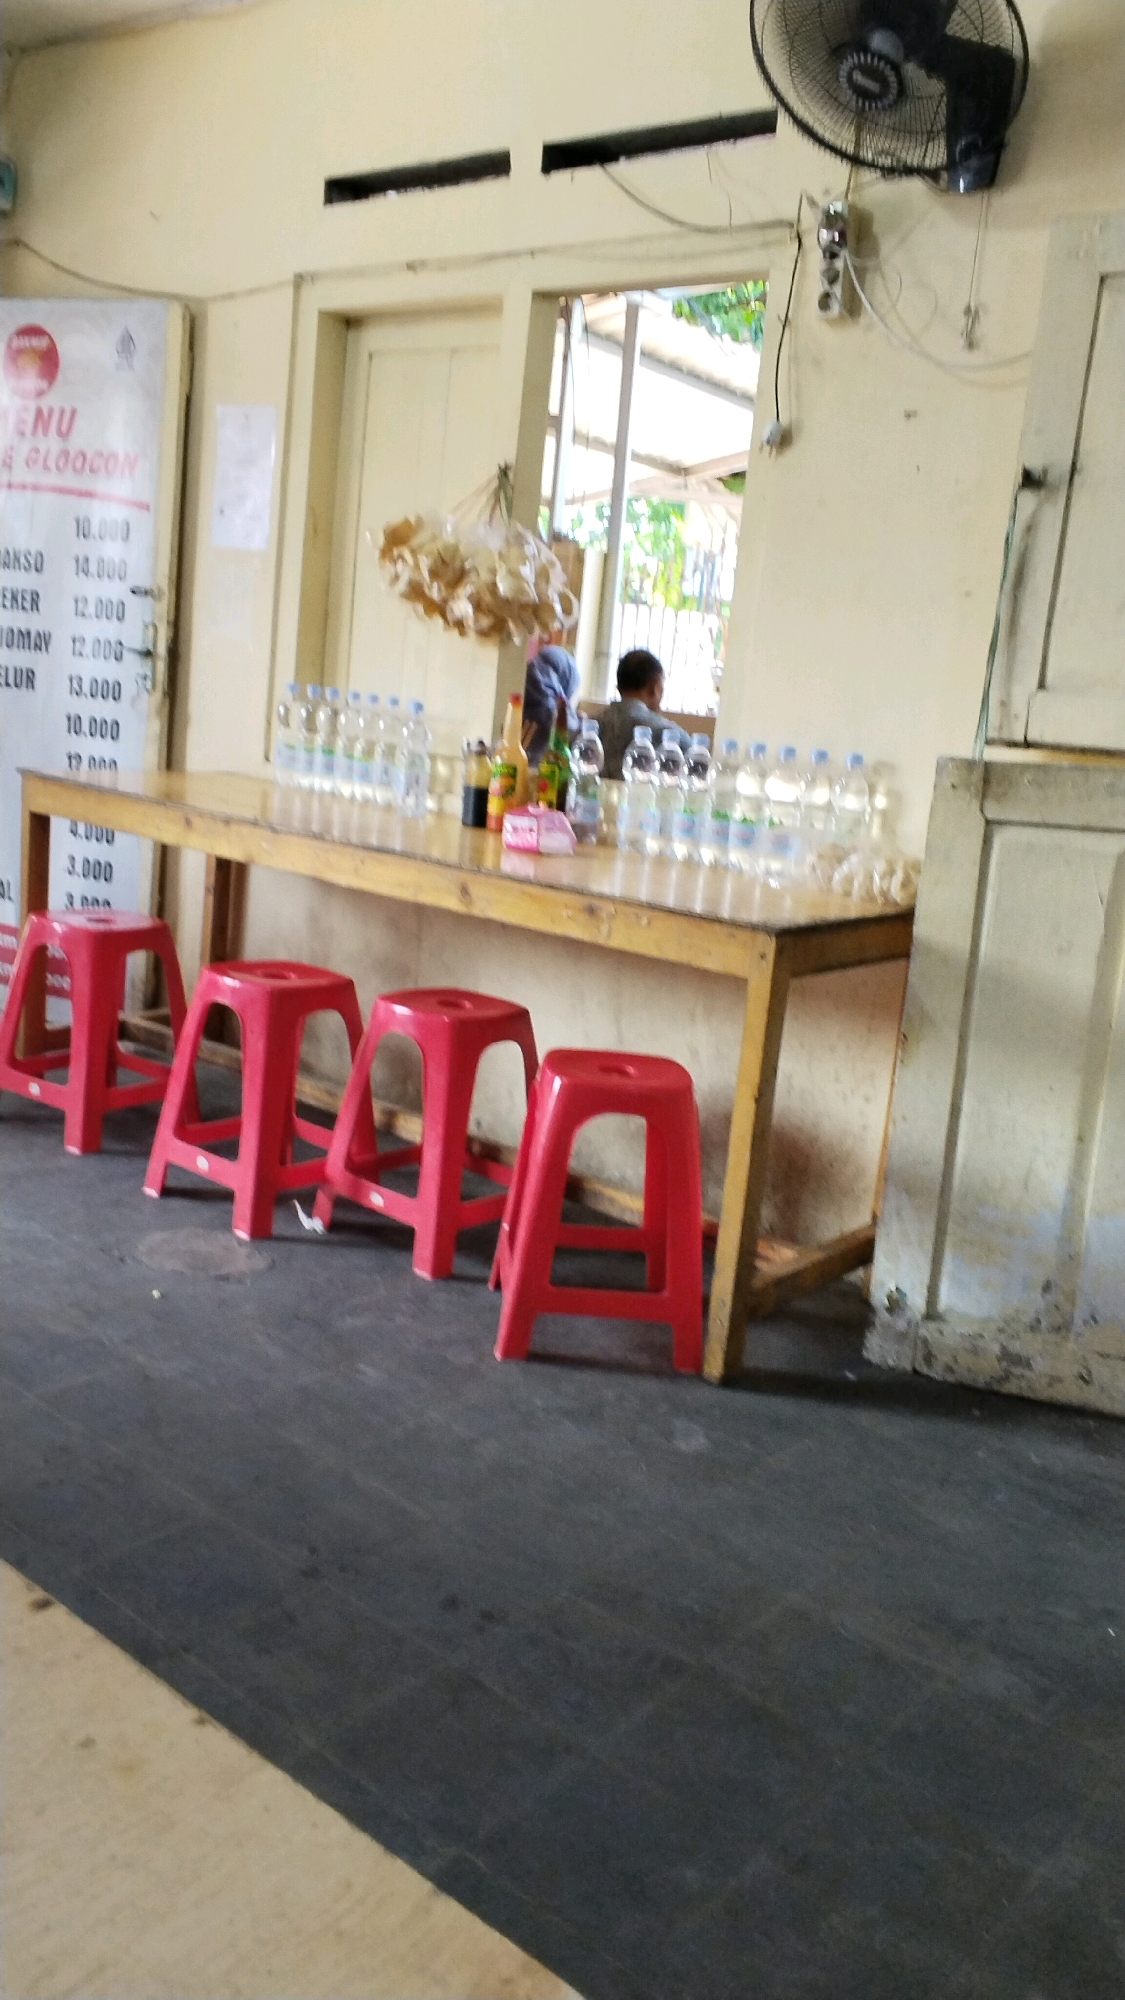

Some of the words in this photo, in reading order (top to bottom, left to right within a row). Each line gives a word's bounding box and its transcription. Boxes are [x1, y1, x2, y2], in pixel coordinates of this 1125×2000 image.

[74, 516, 130, 542] 10.000
[0, 547, 44, 573] AKSO
[73, 594, 127, 622] 12.000
[71, 634, 124, 662] 12.000
[68, 673, 122, 701] 13.000
[66, 712, 120, 741] 10.000
[66, 854, 113, 883] 3.000
